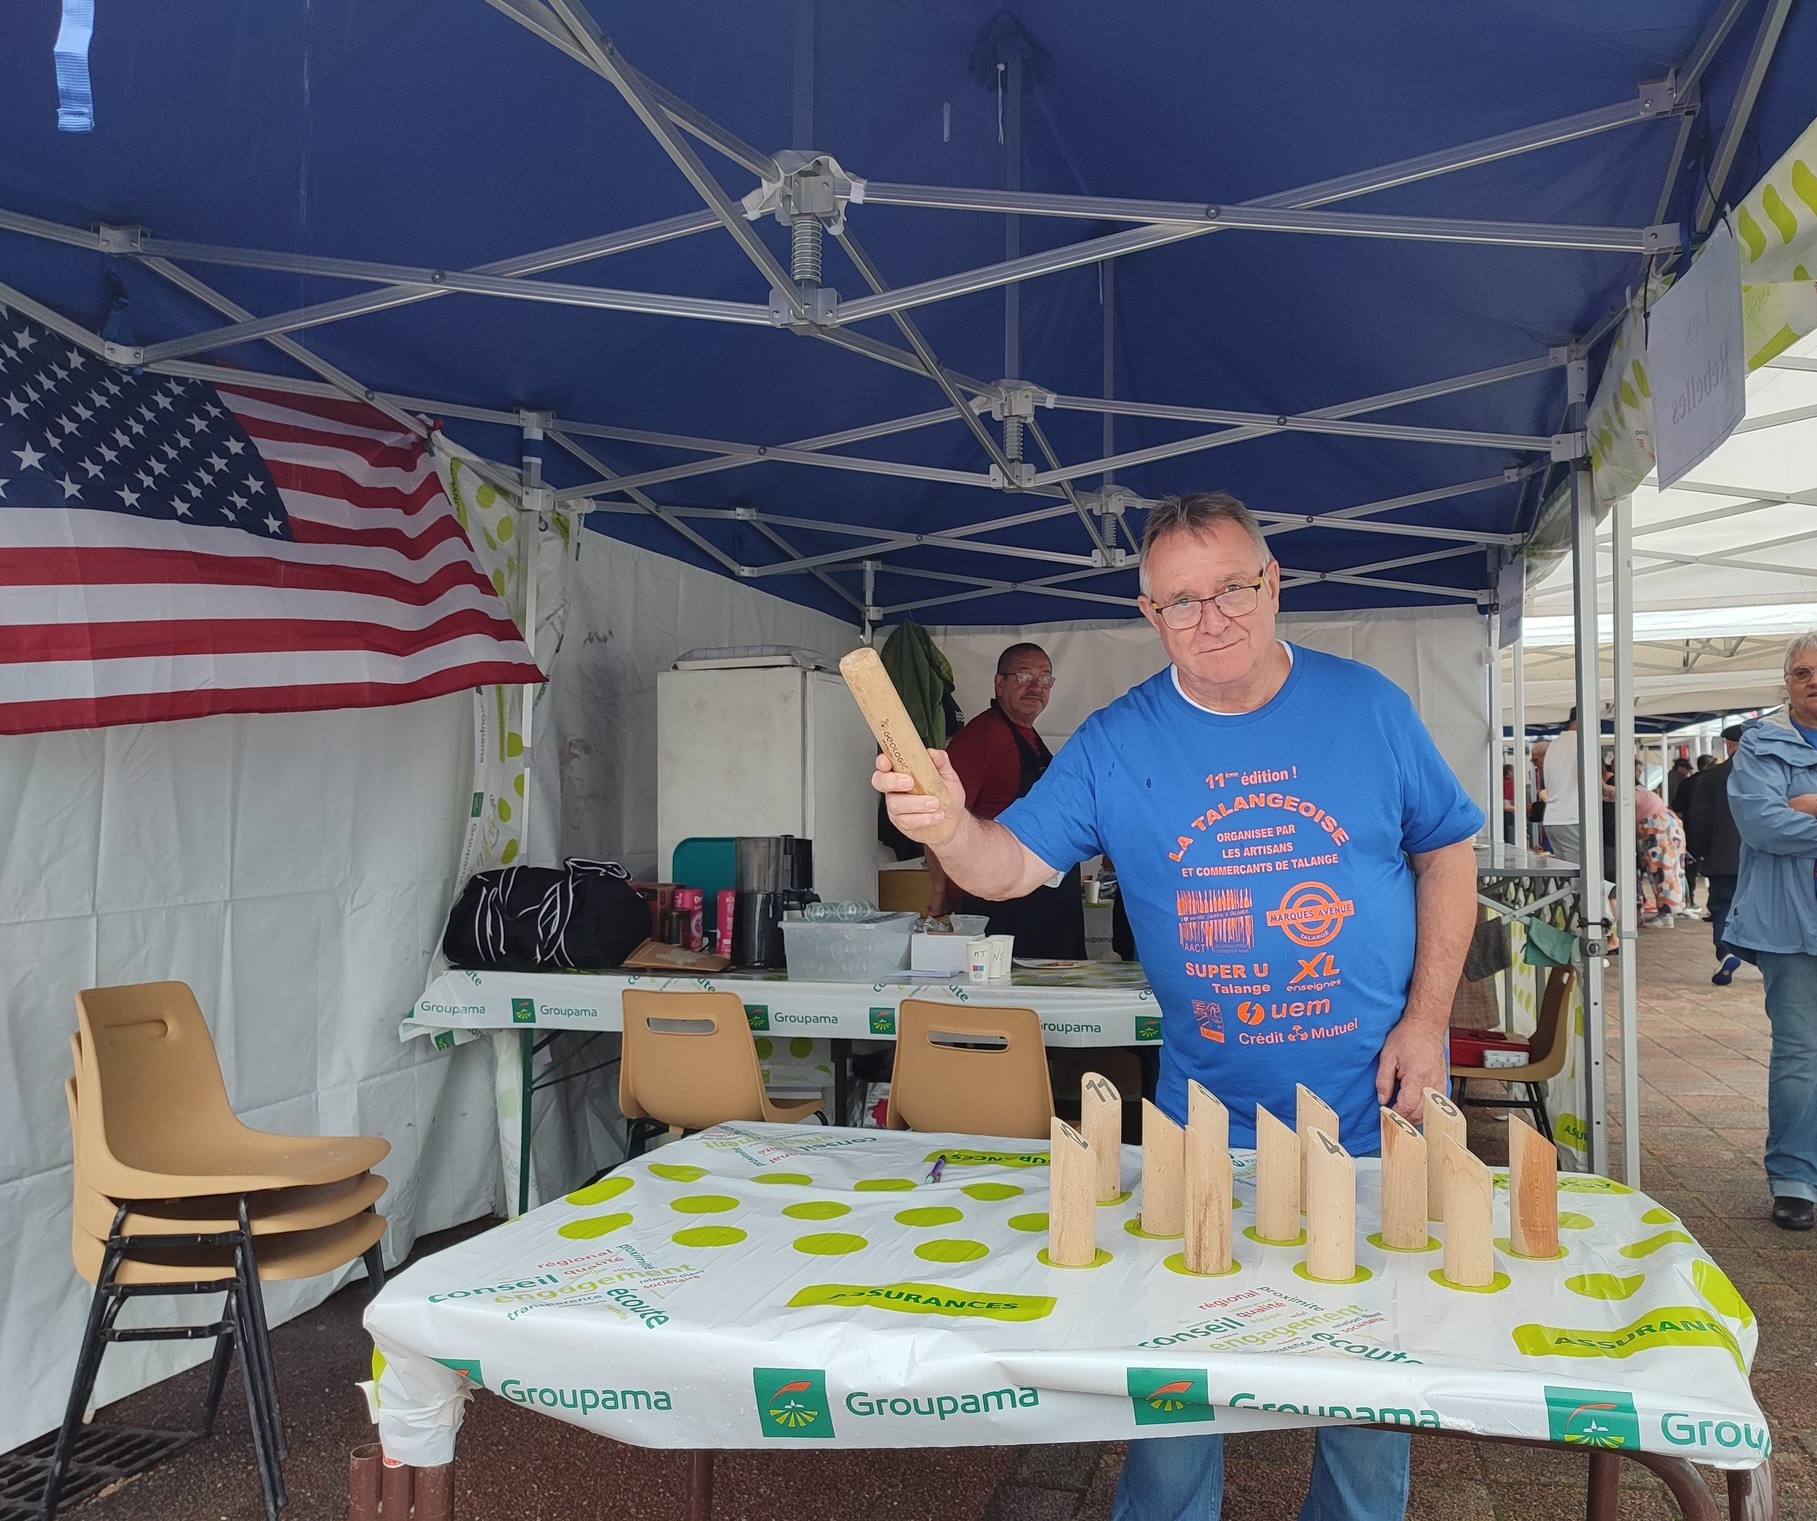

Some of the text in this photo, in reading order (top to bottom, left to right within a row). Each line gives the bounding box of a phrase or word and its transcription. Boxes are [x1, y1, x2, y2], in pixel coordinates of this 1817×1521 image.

[883, 731, 908, 770] GEOLOGIC
[1241, 769, 1289, 786] édition
[1168, 793, 1350, 863] LA TALANGEOISE
[1216, 824, 1296, 843] ORGANISEE PAR
[1222, 842, 1294, 859] LES ARTISANS
[1182, 853, 1339, 878] ET COMMERÇANTS DE TALANGE
[1270, 904, 1352, 923] MARQUES AVENUE
[1300, 930, 1330, 941] TALANGE
[1184, 942, 1206, 953] AACT
[1185, 962, 1269, 979] SUPER U
[1289, 951, 1340, 984] XL
[1211, 982, 1271, 995] Talange
[1286, 978, 1342, 993] enseignes
[420, 1001, 486, 1017] Groupama
[540, 1004, 598, 1019] Groupama
[774, 1012, 839, 1025] Groupama
[1271, 998, 1331, 1018] uem
[1041, 1022, 1102, 1035] roupama
[1239, 1031, 1285, 1046] Crédit
[1311, 1017, 1359, 1040] Mutuel
[1085, 1078, 1118, 1103] 11
[1430, 1093, 1458, 1117] 3
[1317, 1131, 1345, 1157] 4
[537, 1248, 613, 1269] régional
[563, 1256, 625, 1276] qualité
[427, 1273, 559, 1304] conseil
[495, 1263, 696, 1304] engagement
[606, 1288, 670, 1330] écoute
[1198, 1289, 1260, 1311] régional
[1235, 1300, 1286, 1319] qualité
[1256, 1286, 1327, 1312] proximité
[1209, 1304, 1365, 1351] engagement
[500, 1379, 673, 1416] Groupama
[845, 1386, 1039, 1421] Groupama
[1661, 1412, 1770, 1459] Grou
